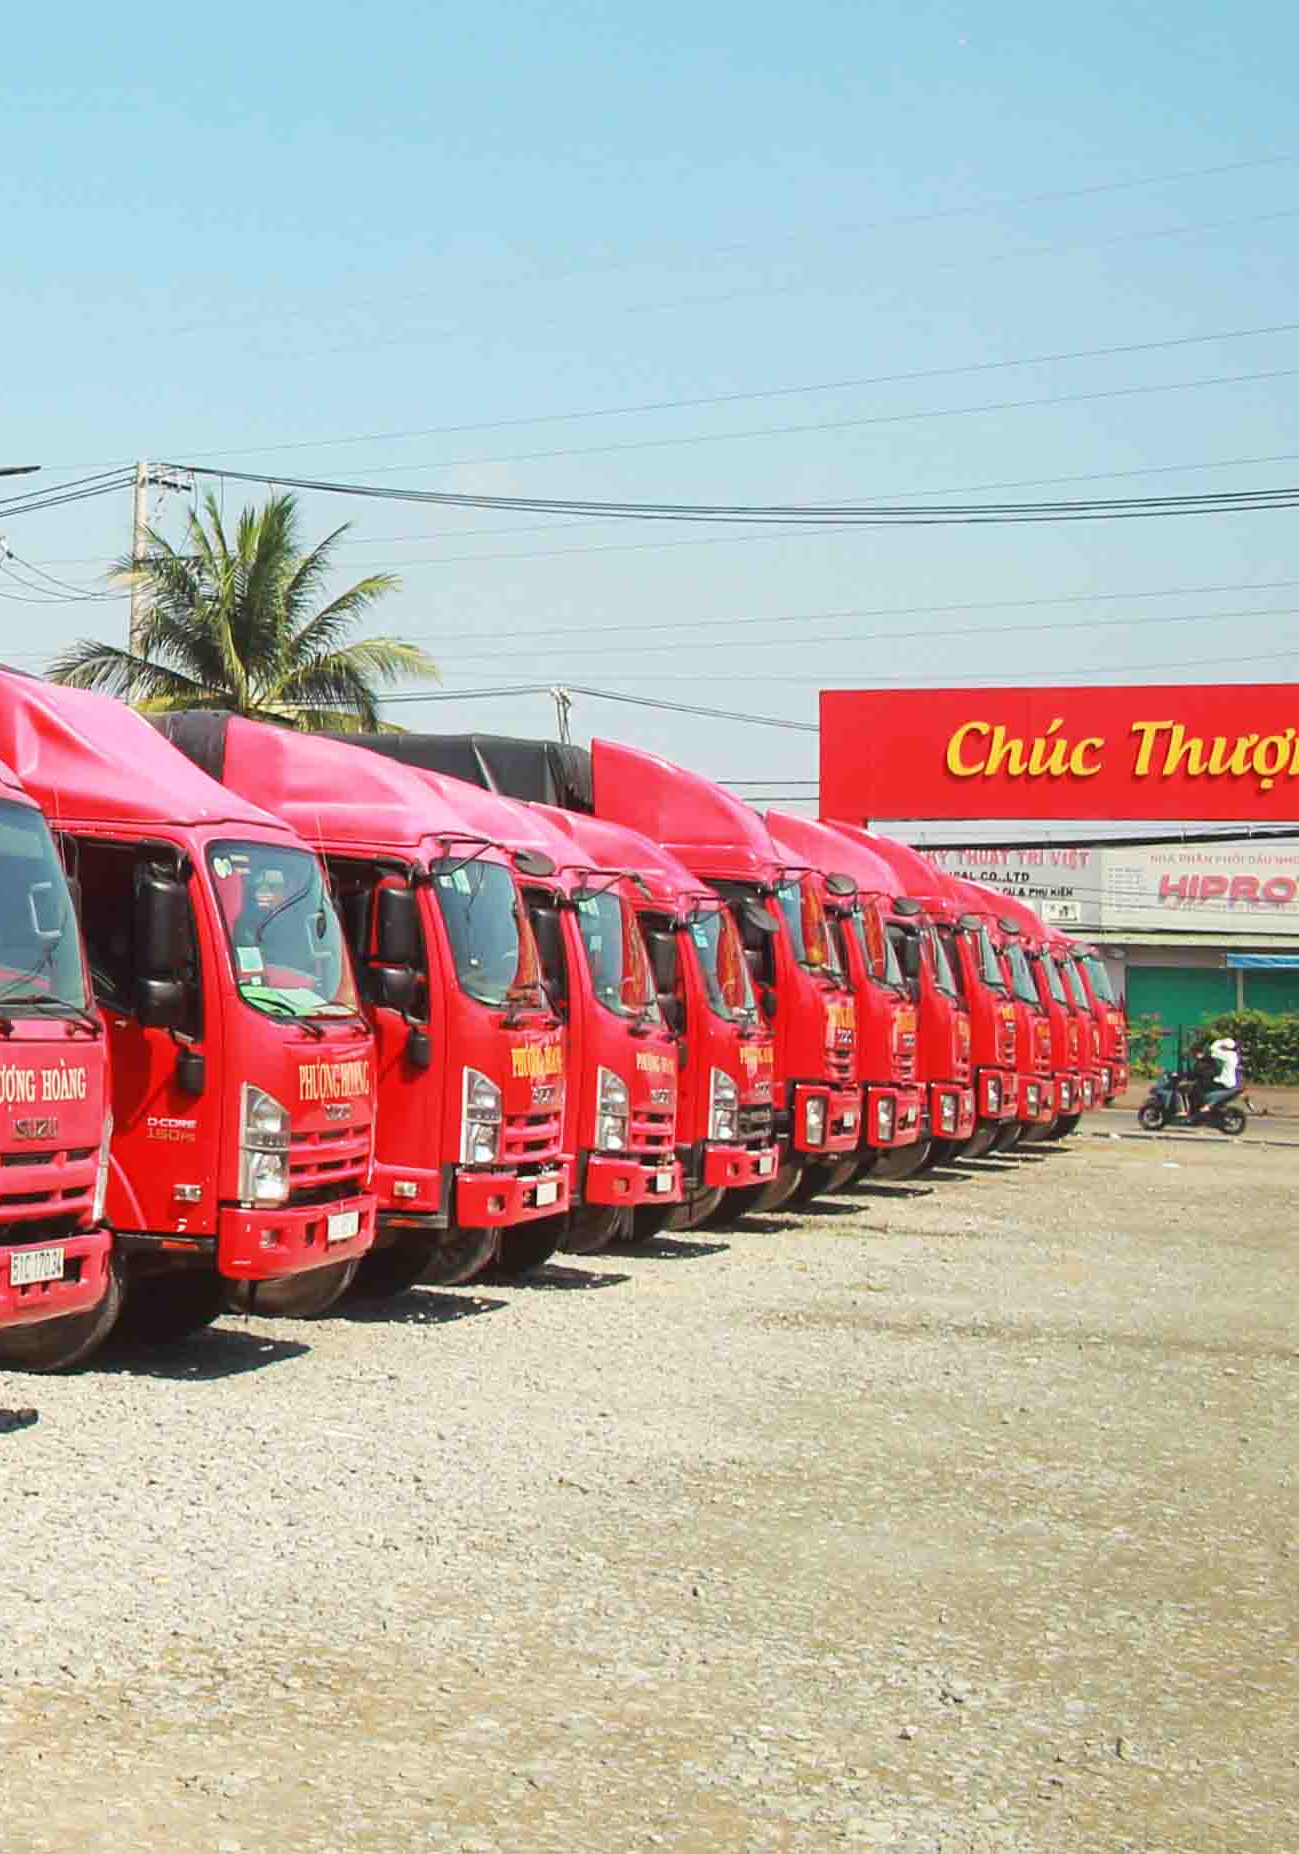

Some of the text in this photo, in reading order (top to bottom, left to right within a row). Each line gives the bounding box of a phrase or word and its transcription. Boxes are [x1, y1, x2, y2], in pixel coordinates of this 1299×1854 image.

[946, 718, 1299, 790] Chúc Thượ
[41, 1057, 87, 1101] HOÀNG
[147, 1116, 198, 1129] D-CORE
